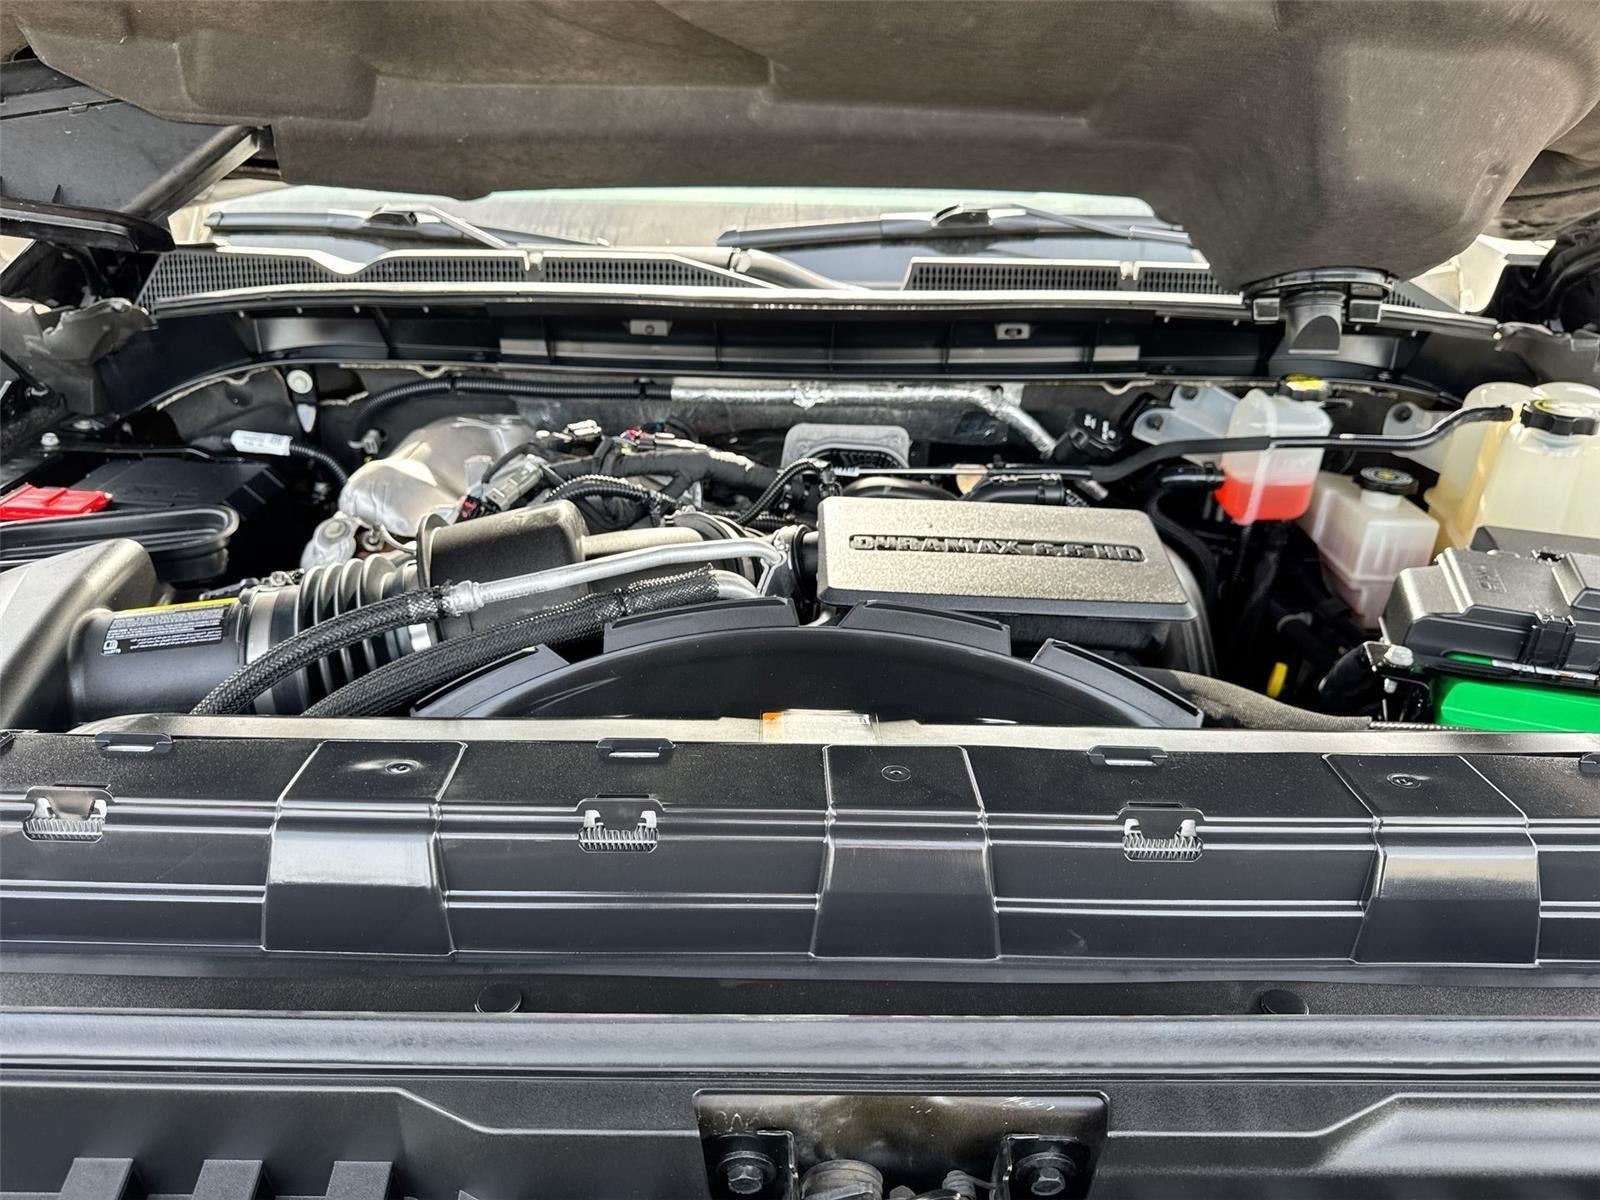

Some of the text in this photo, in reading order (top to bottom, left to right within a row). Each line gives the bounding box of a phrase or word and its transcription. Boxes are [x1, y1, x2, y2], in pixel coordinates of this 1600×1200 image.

[851, 536, 1145, 561] DURAMAX 6.6 HD
